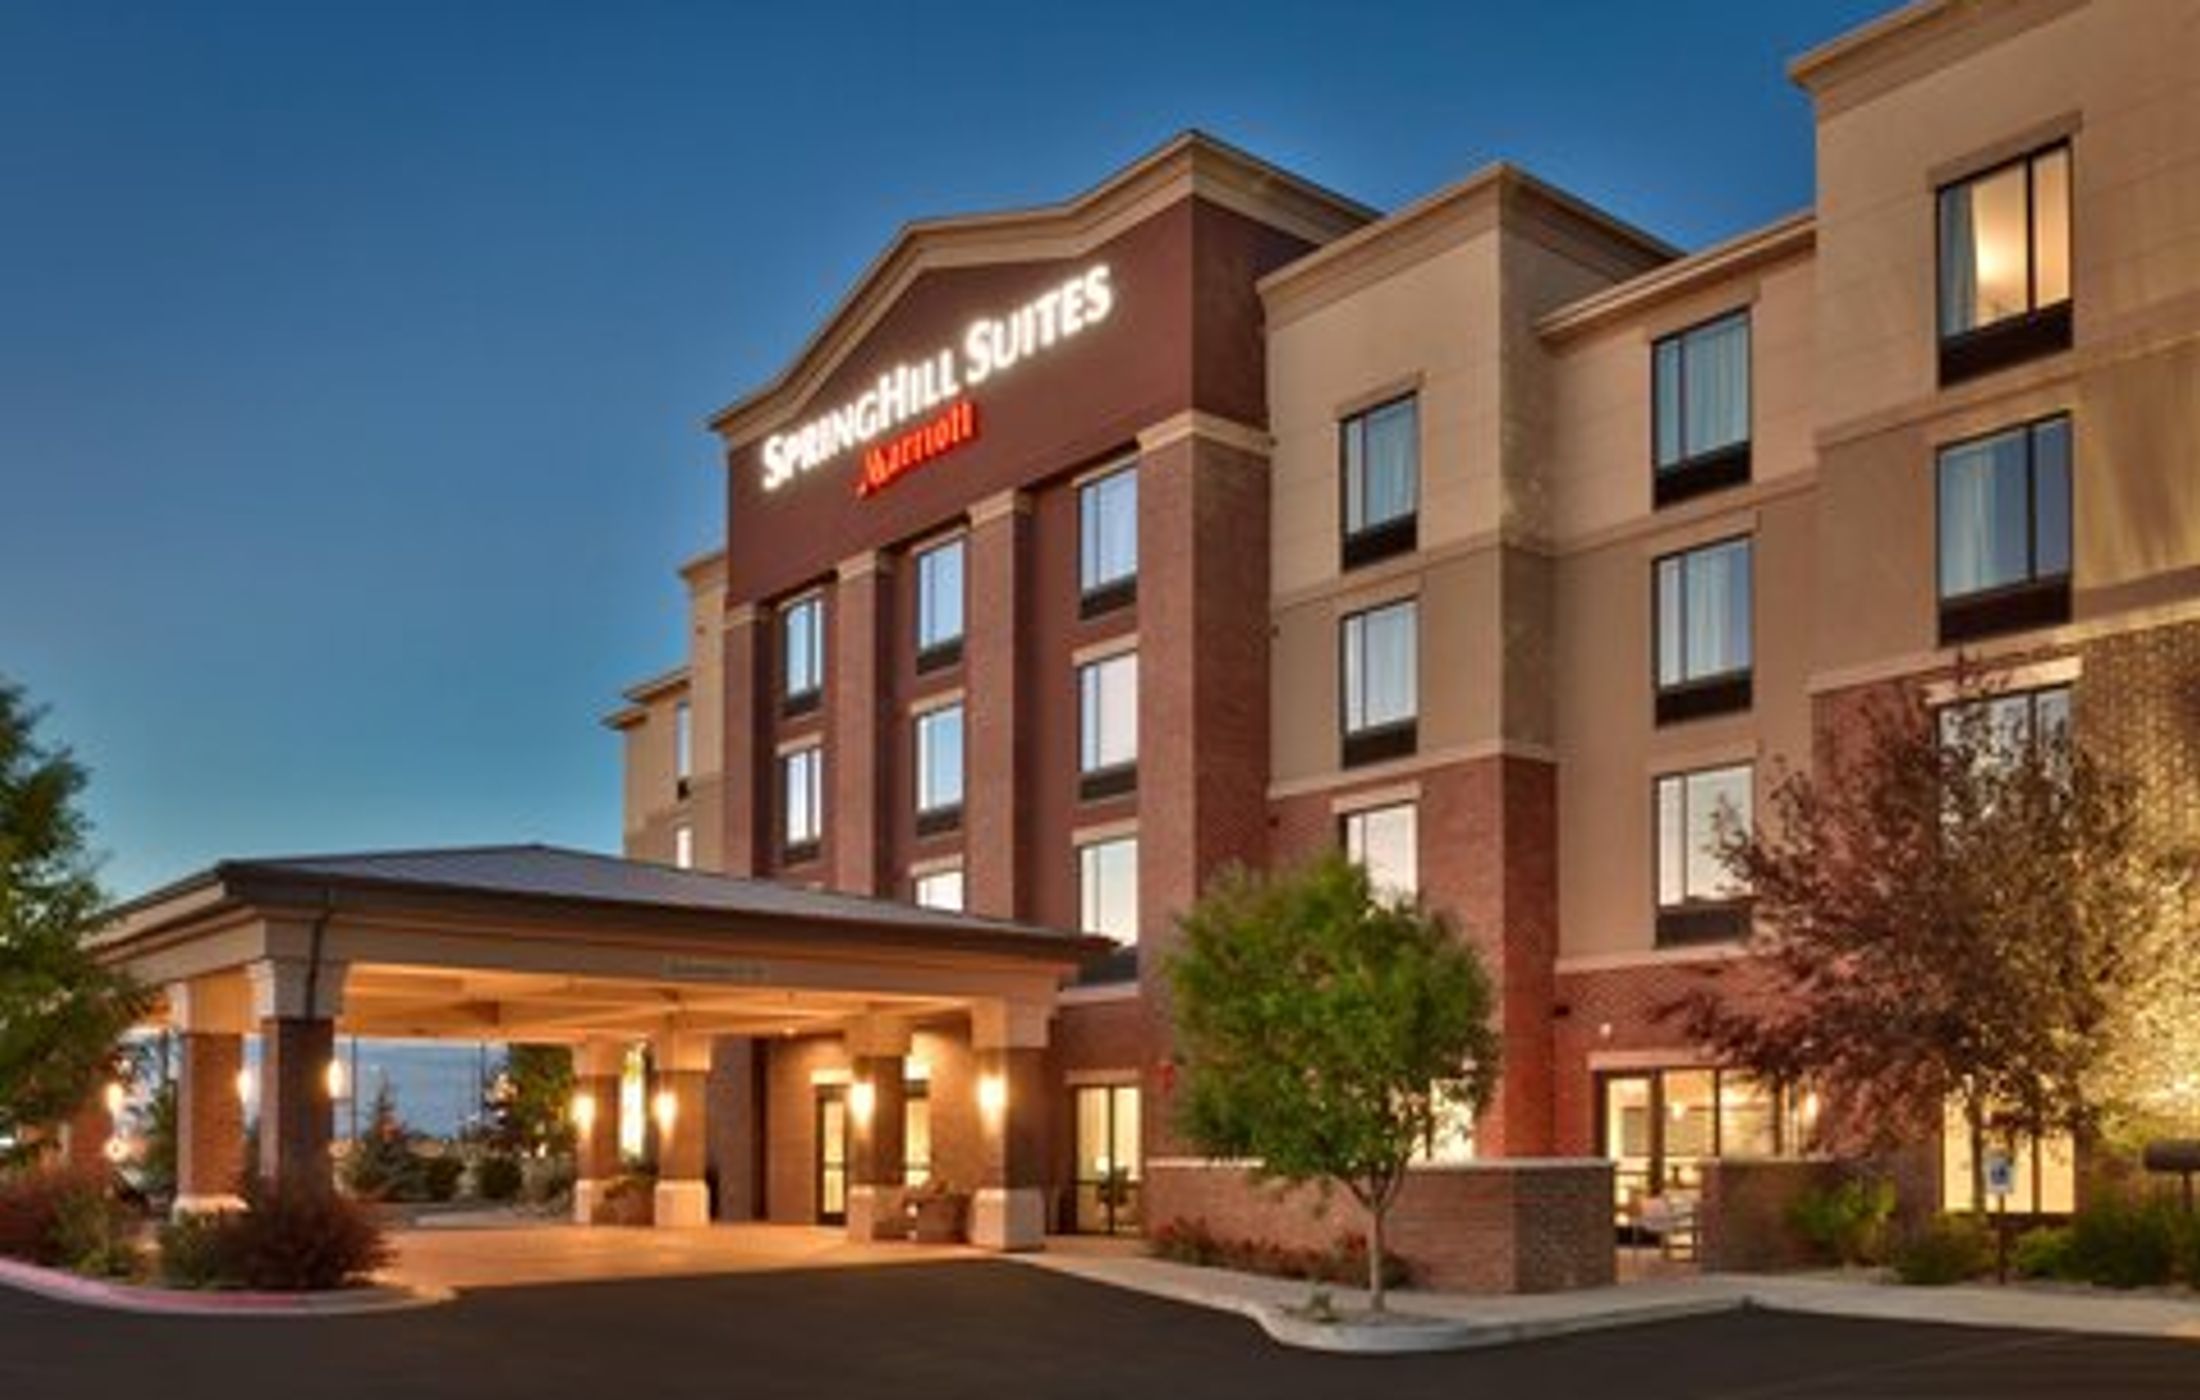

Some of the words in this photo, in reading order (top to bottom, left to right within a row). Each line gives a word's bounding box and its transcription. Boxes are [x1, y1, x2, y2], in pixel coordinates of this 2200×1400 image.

[761, 348, 959, 490] SPRINGHILL
[965, 264, 1113, 385] SUITES
[856, 400, 976, 496] Marriott
